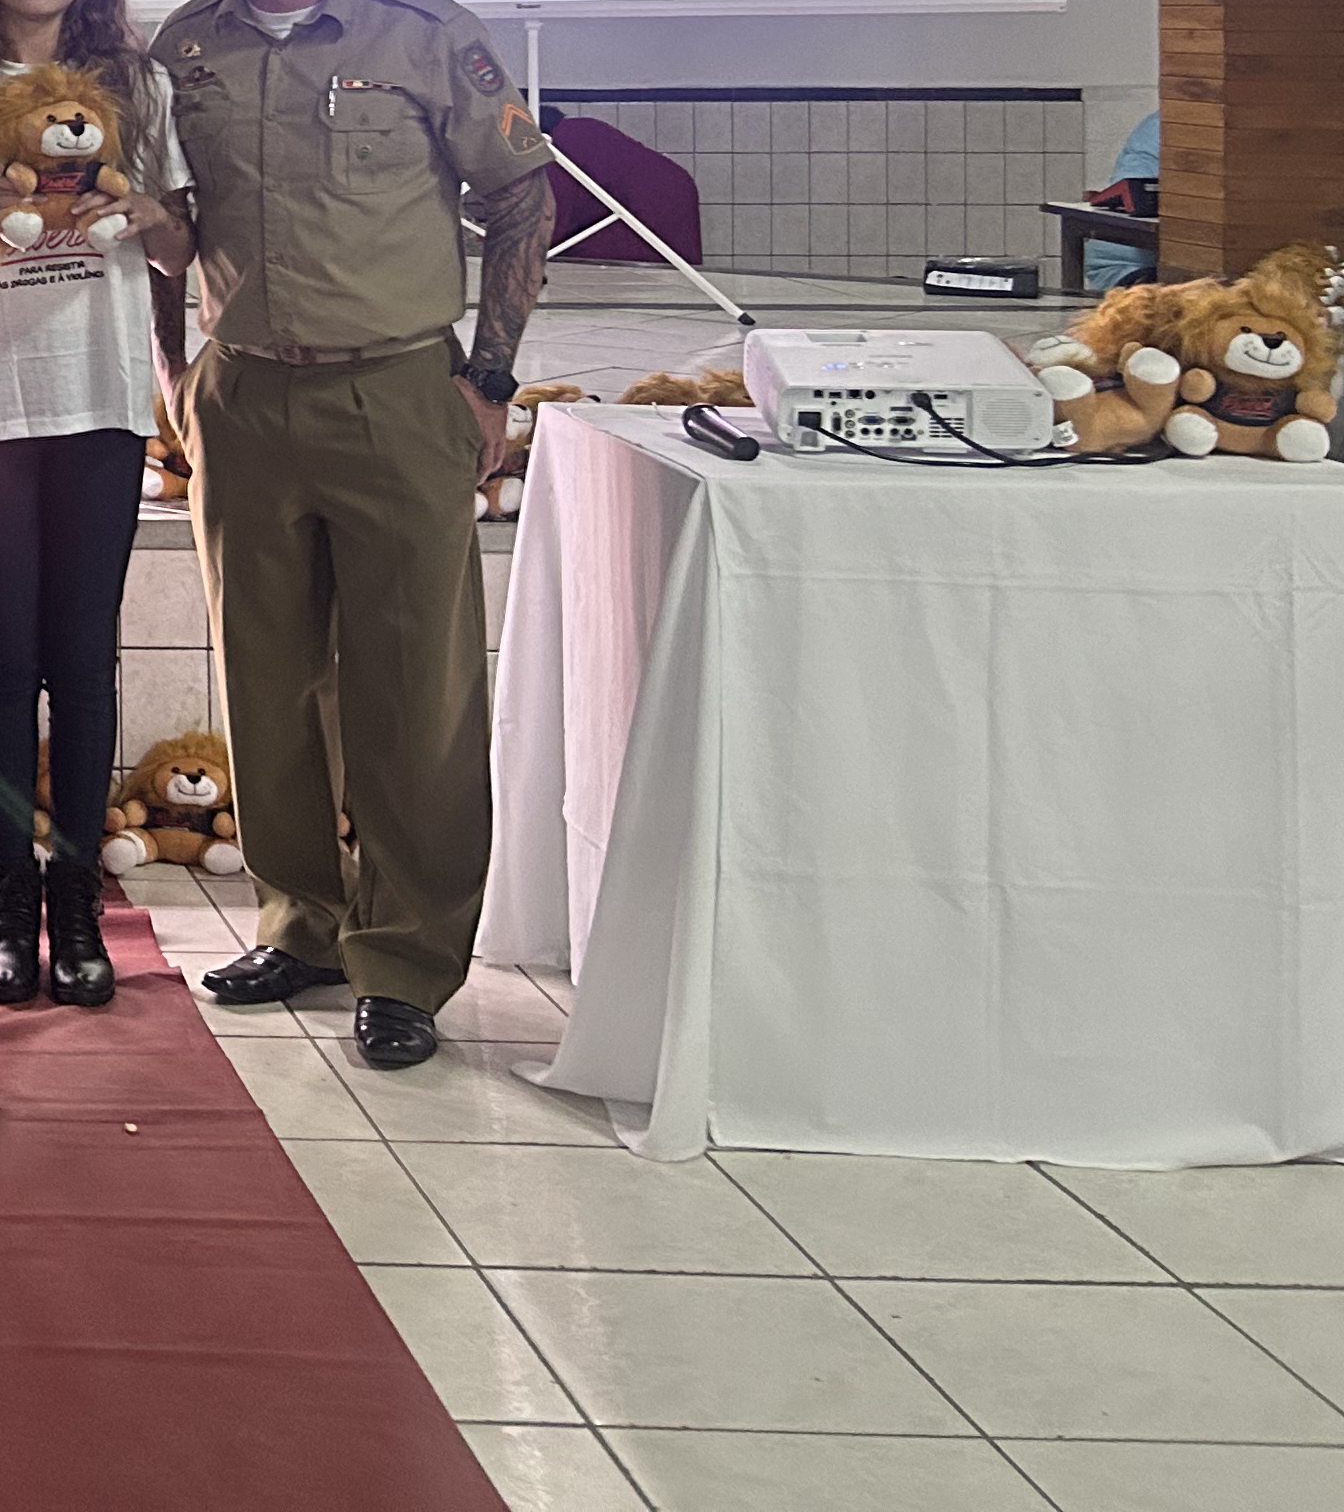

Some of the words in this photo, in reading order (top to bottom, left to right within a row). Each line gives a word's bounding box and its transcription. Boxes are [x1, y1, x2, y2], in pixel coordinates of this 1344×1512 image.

[19, 265, 43, 275] PARA
[11, 277, 47, 288] DROGAS
[49, 275, 56, 284] E
